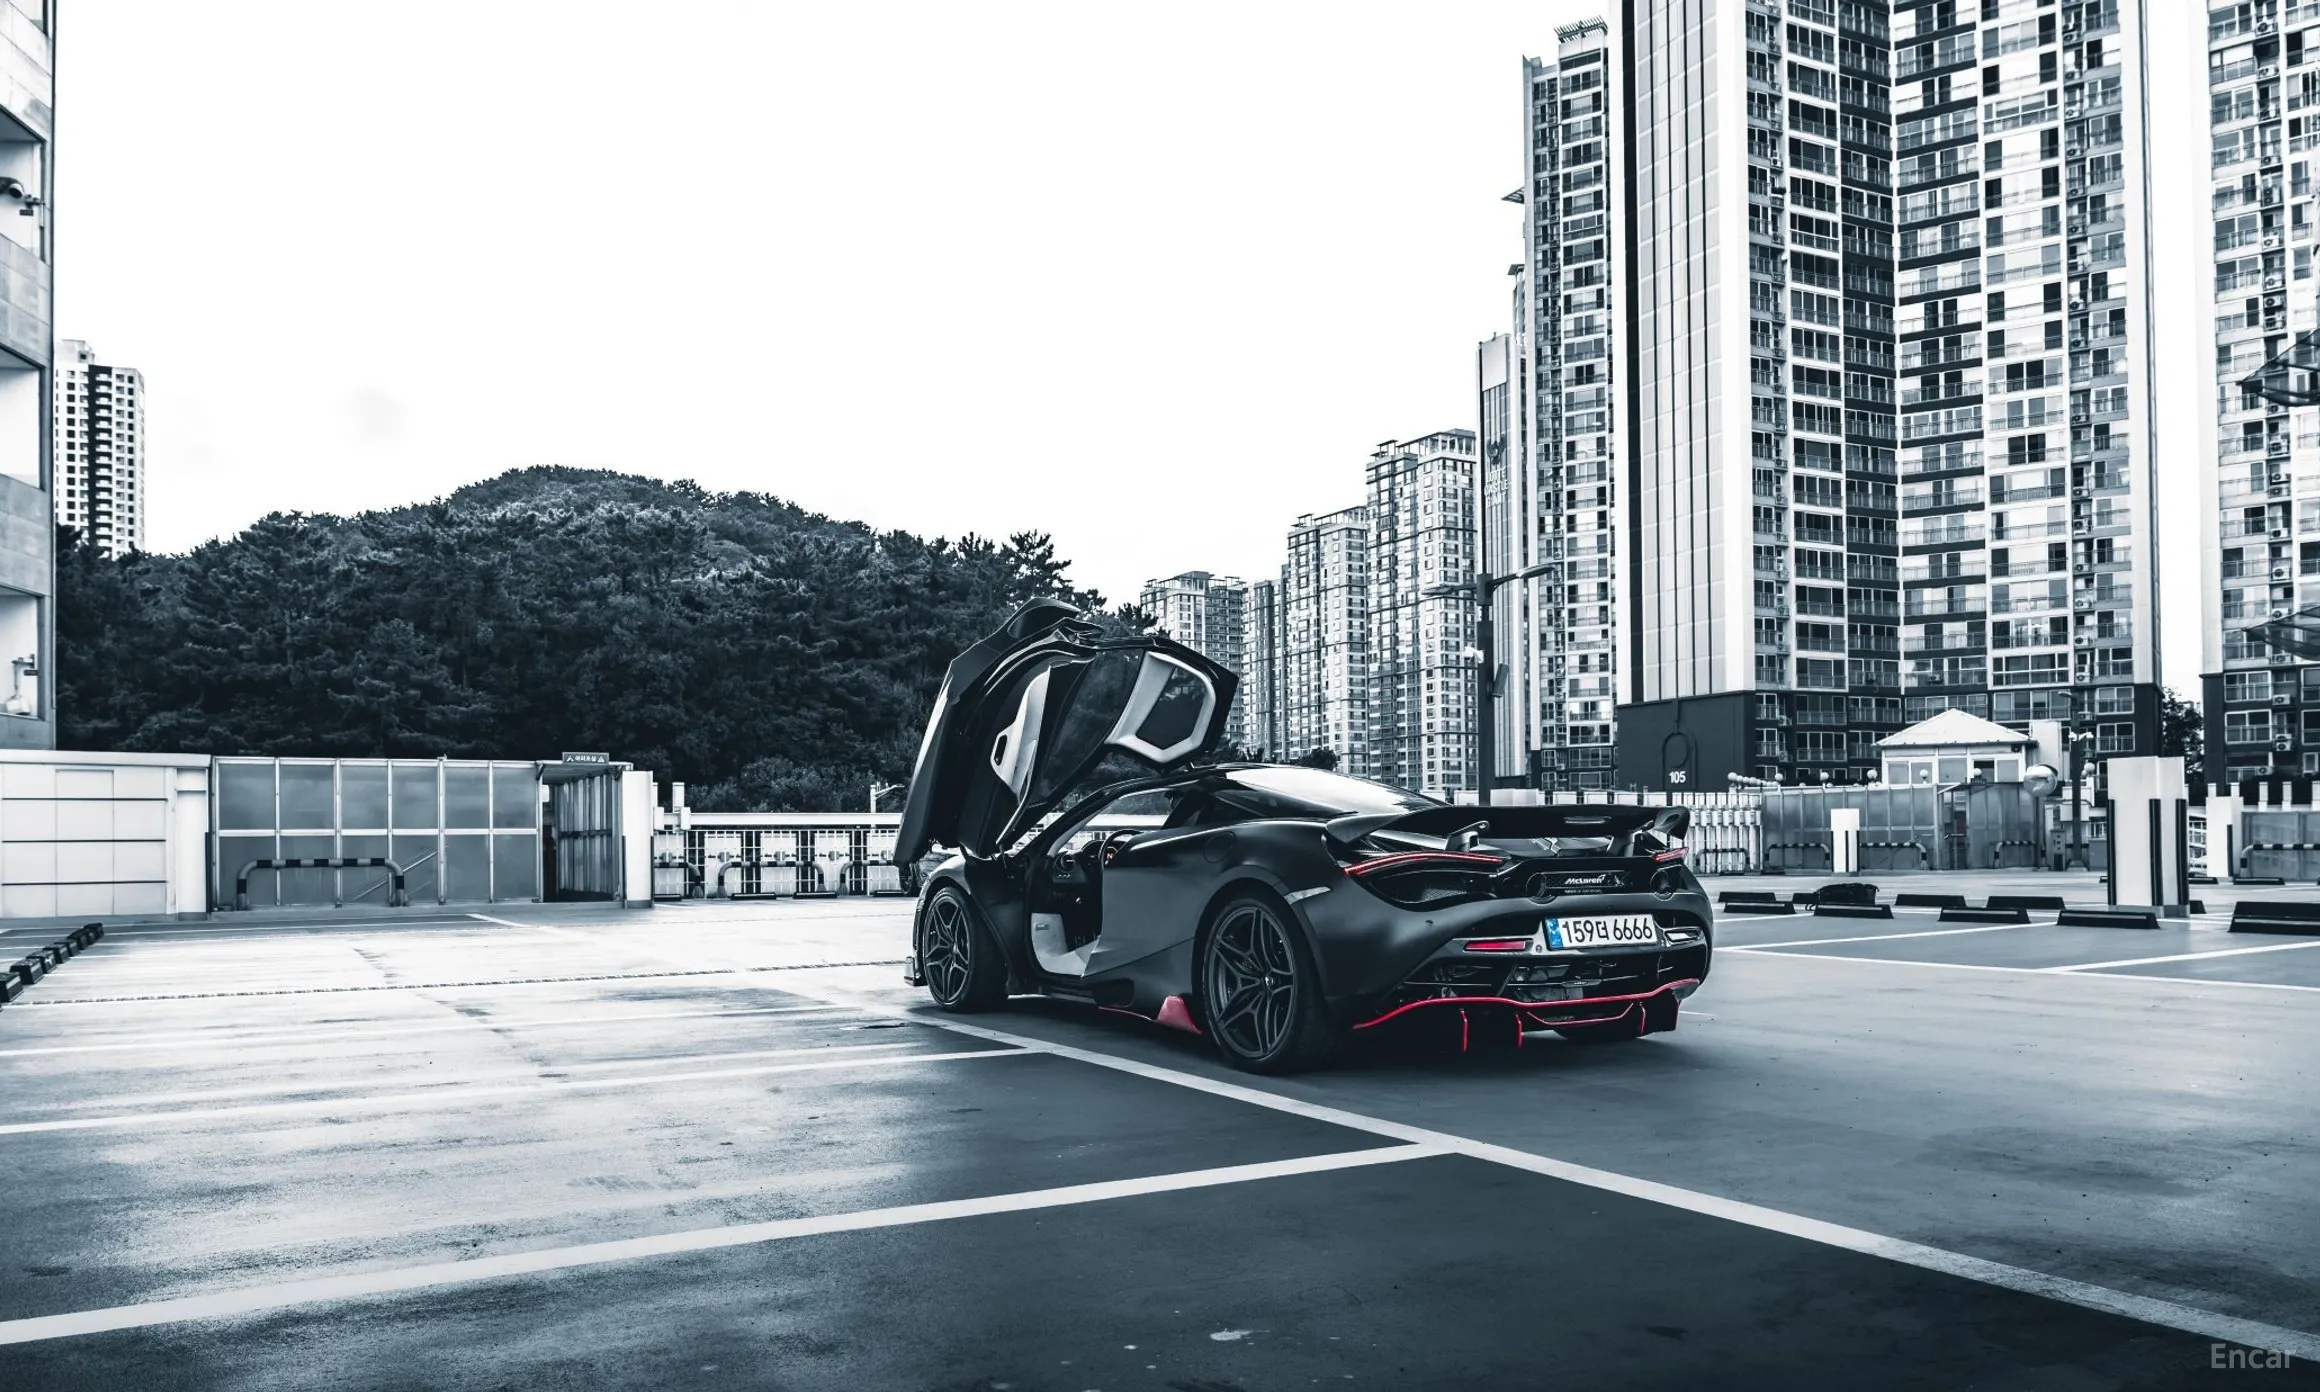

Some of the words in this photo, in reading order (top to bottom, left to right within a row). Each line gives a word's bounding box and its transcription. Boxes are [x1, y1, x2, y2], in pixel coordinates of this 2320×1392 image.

[1669, 771, 1686, 784] 105
[1564, 877, 1603, 885] McLaren
[1562, 920, 1609, 943] 159더
[1613, 918, 1652, 941] 6666
